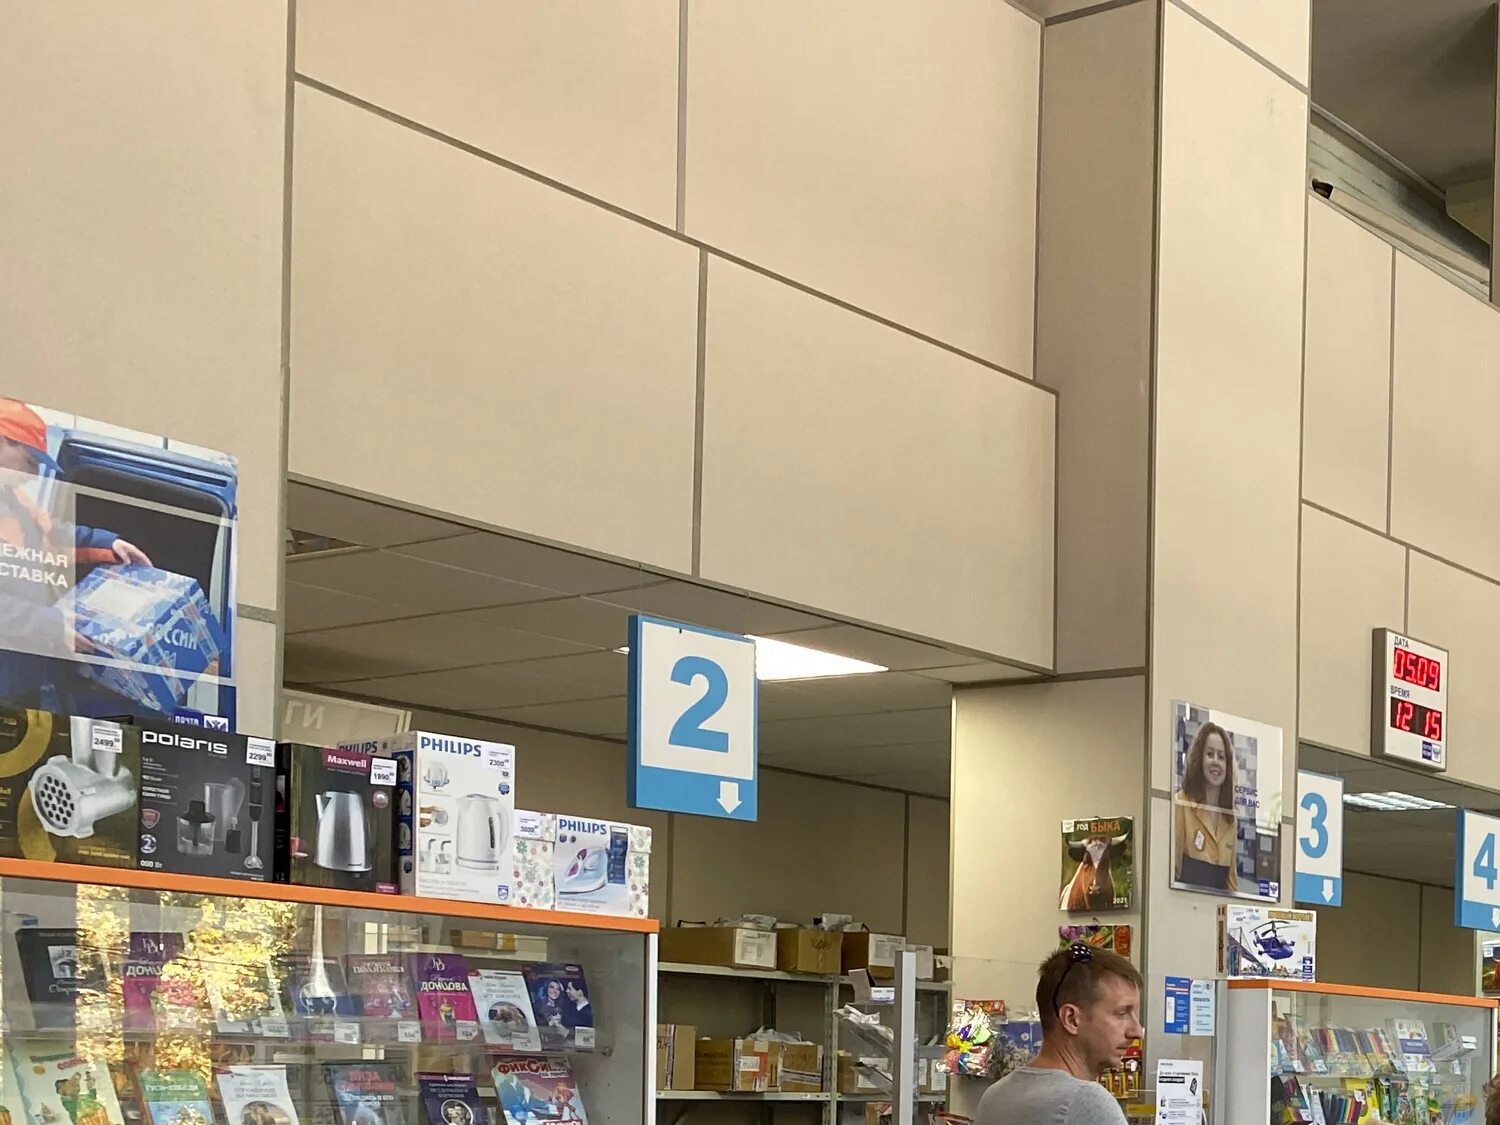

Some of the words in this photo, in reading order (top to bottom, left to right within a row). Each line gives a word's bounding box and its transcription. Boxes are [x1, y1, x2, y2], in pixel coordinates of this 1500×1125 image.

[0, 543, 68, 568] ЕЖНАЯ
[1394, 636, 1409, 648] ДАТА
[1390, 685, 1410, 699] ВРЕМЯ
[669, 656, 729, 753] 2
[1396, 701, 1414, 732] 12
[1424, 711, 1441, 740] 15
[142, 731, 228, 755] polaris
[420, 736, 482, 758] PHILIPS
[327, 754, 368, 769] Maxwell
[1234, 784, 1258, 798] СЕРВИС
[559, 819, 607, 835] PHILIPS
[1091, 821, 1121, 832] БЫКА
[1299, 792, 1329, 859] 3
[1473, 832, 1498, 890] 4
[420, 981, 469, 991] ДОНЦОВА
